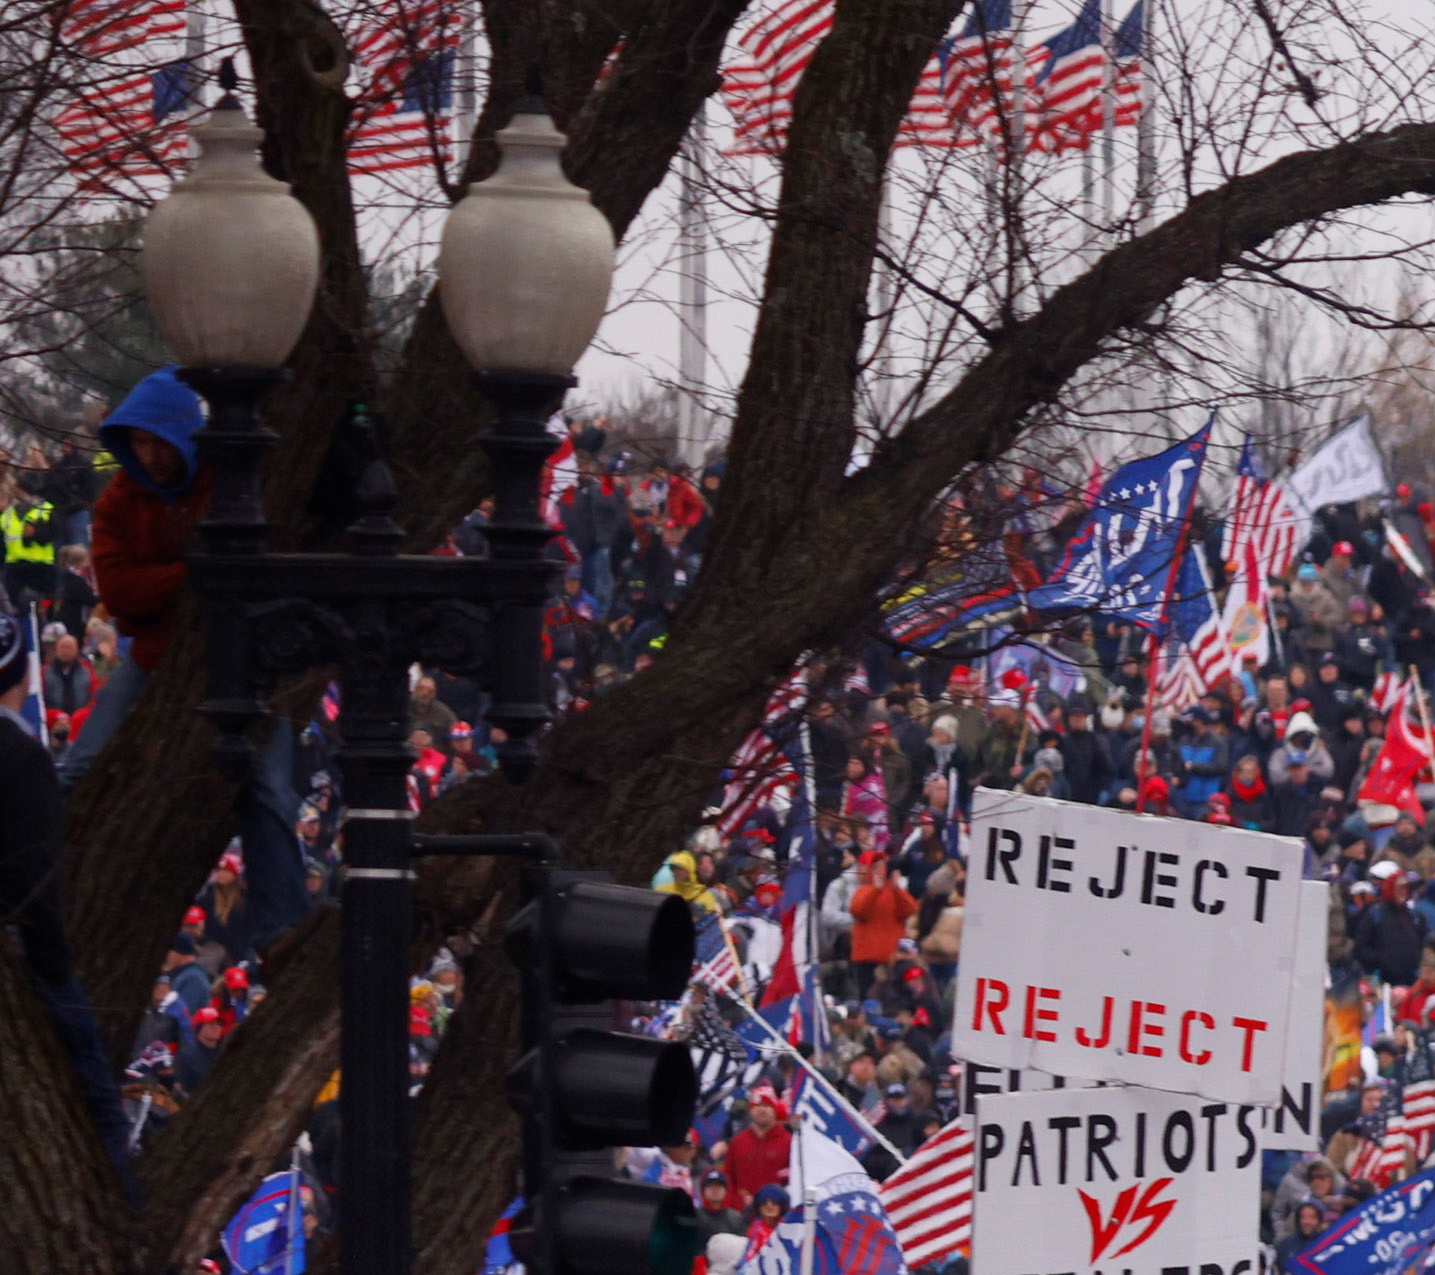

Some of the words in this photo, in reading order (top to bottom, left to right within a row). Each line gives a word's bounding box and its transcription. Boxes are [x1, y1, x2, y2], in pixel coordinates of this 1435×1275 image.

[985, 827, 1281, 923] REJECT
[972, 976, 1269, 1073] REJECT
[979, 1100, 1258, 1191] PATRIOTS
[1077, 1177, 1178, 1263] VS
